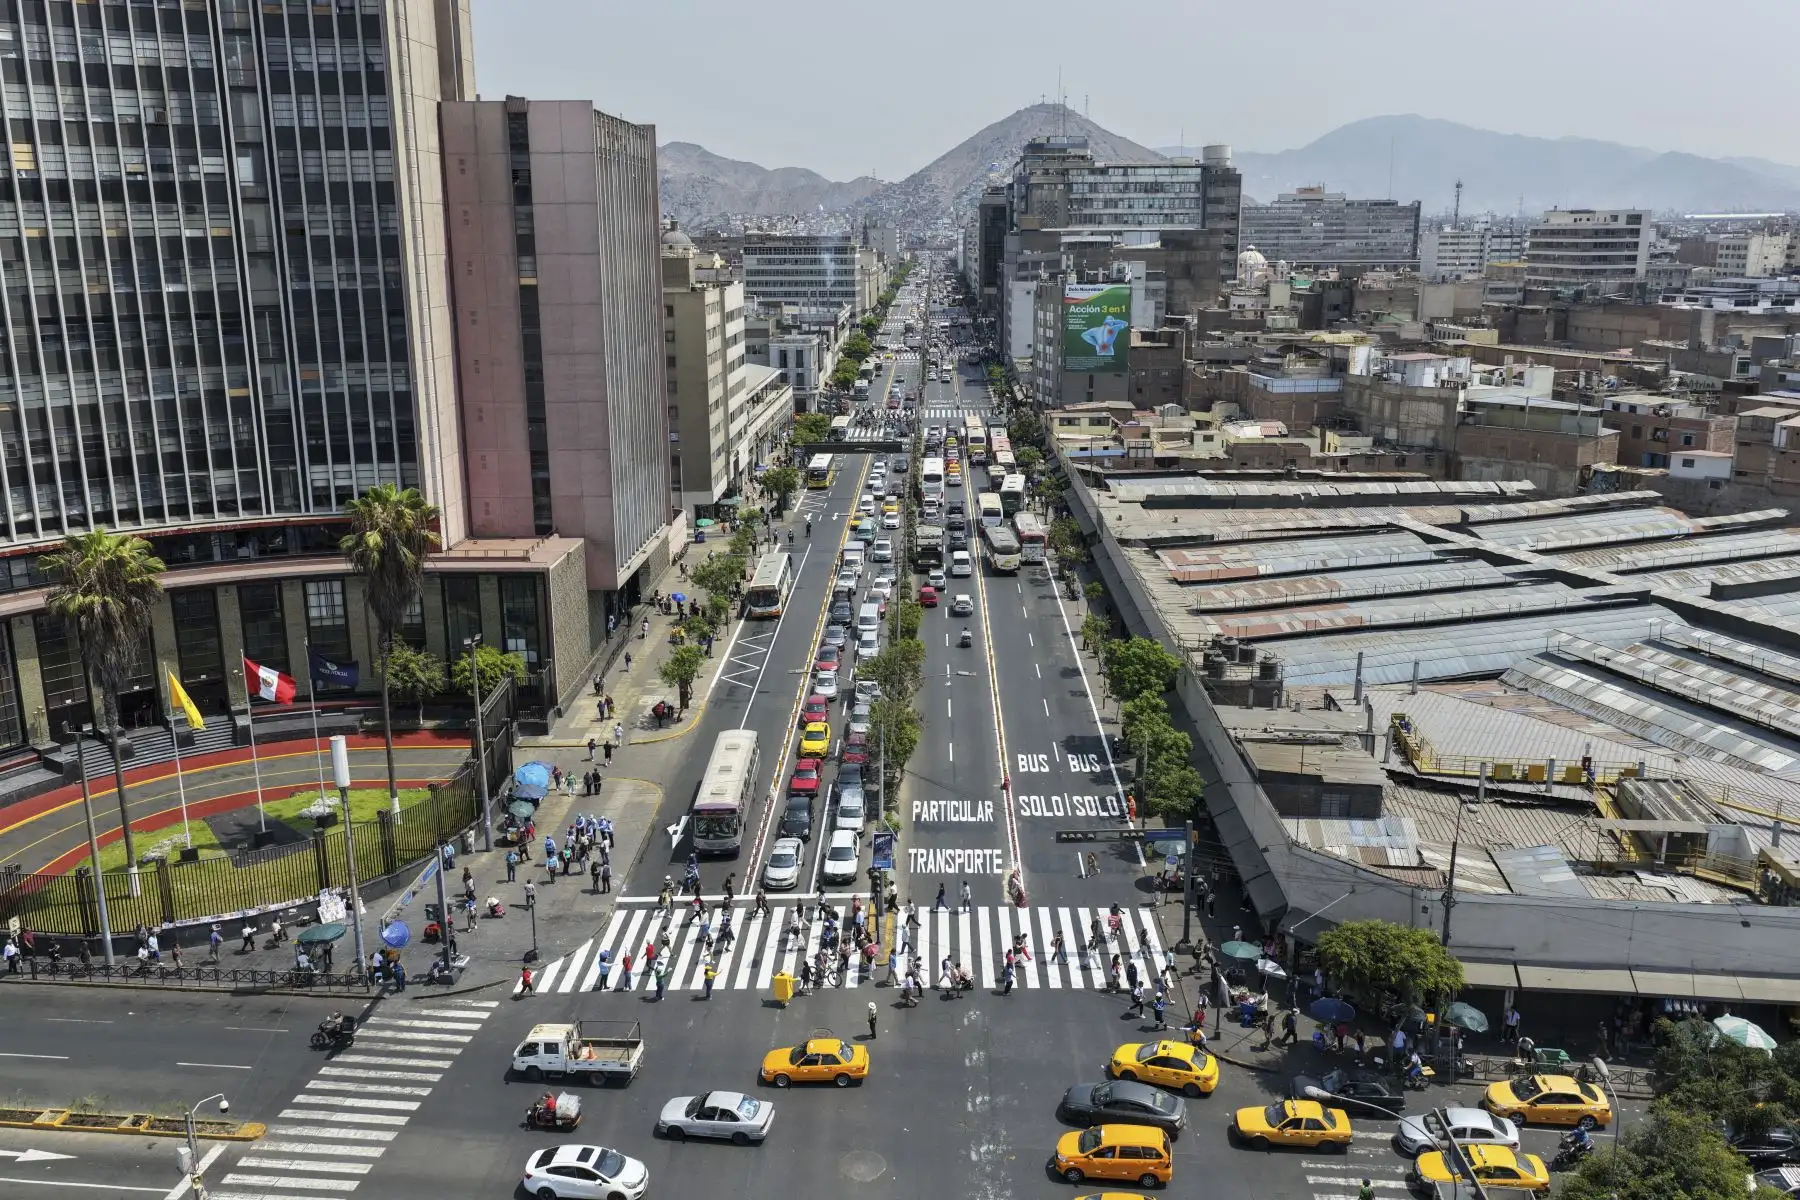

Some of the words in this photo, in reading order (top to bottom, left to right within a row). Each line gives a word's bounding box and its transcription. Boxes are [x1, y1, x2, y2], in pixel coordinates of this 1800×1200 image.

[1069, 305, 1100, 313] Acción
[1101, 305, 1107, 313] 3
[1121, 305, 1126, 313] 1
[1018, 754, 1050, 773] BUS
[1067, 754, 1101, 773] BUS
[912, 800, 994, 822] PARTICULAR
[1019, 795, 1065, 817] SOLO
[1072, 795, 1120, 817] SOLO
[908, 848, 1003, 874] TRANSPORTE
